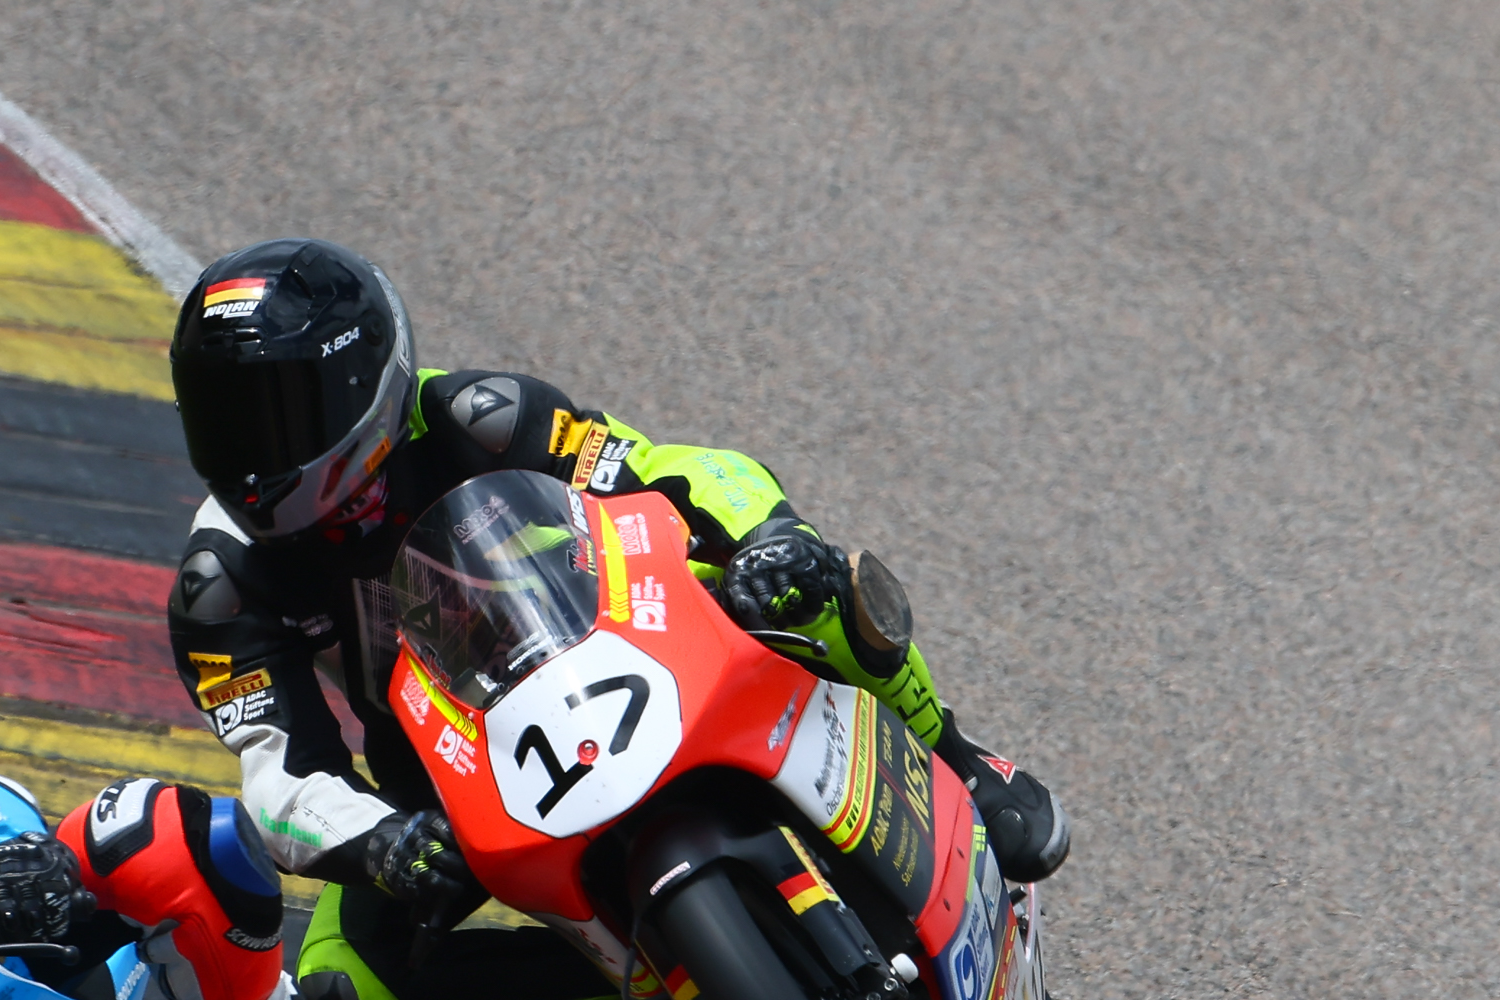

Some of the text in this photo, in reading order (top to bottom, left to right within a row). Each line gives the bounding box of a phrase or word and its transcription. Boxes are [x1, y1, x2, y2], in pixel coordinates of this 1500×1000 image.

[203, 301, 259, 319] NOLAN
[321, 326, 360, 358] X-804
[575, 430, 605, 484] PIRELLI
[205, 673, 265, 706] PIRELLI
[244, 697, 275, 713] Stiftung
[245, 690, 267, 703] ADAC
[243, 708, 265, 721] Sport
[514, 674, 650, 820] 17
[881, 720, 893, 769] TEAM
[904, 728, 930, 833] NSA
